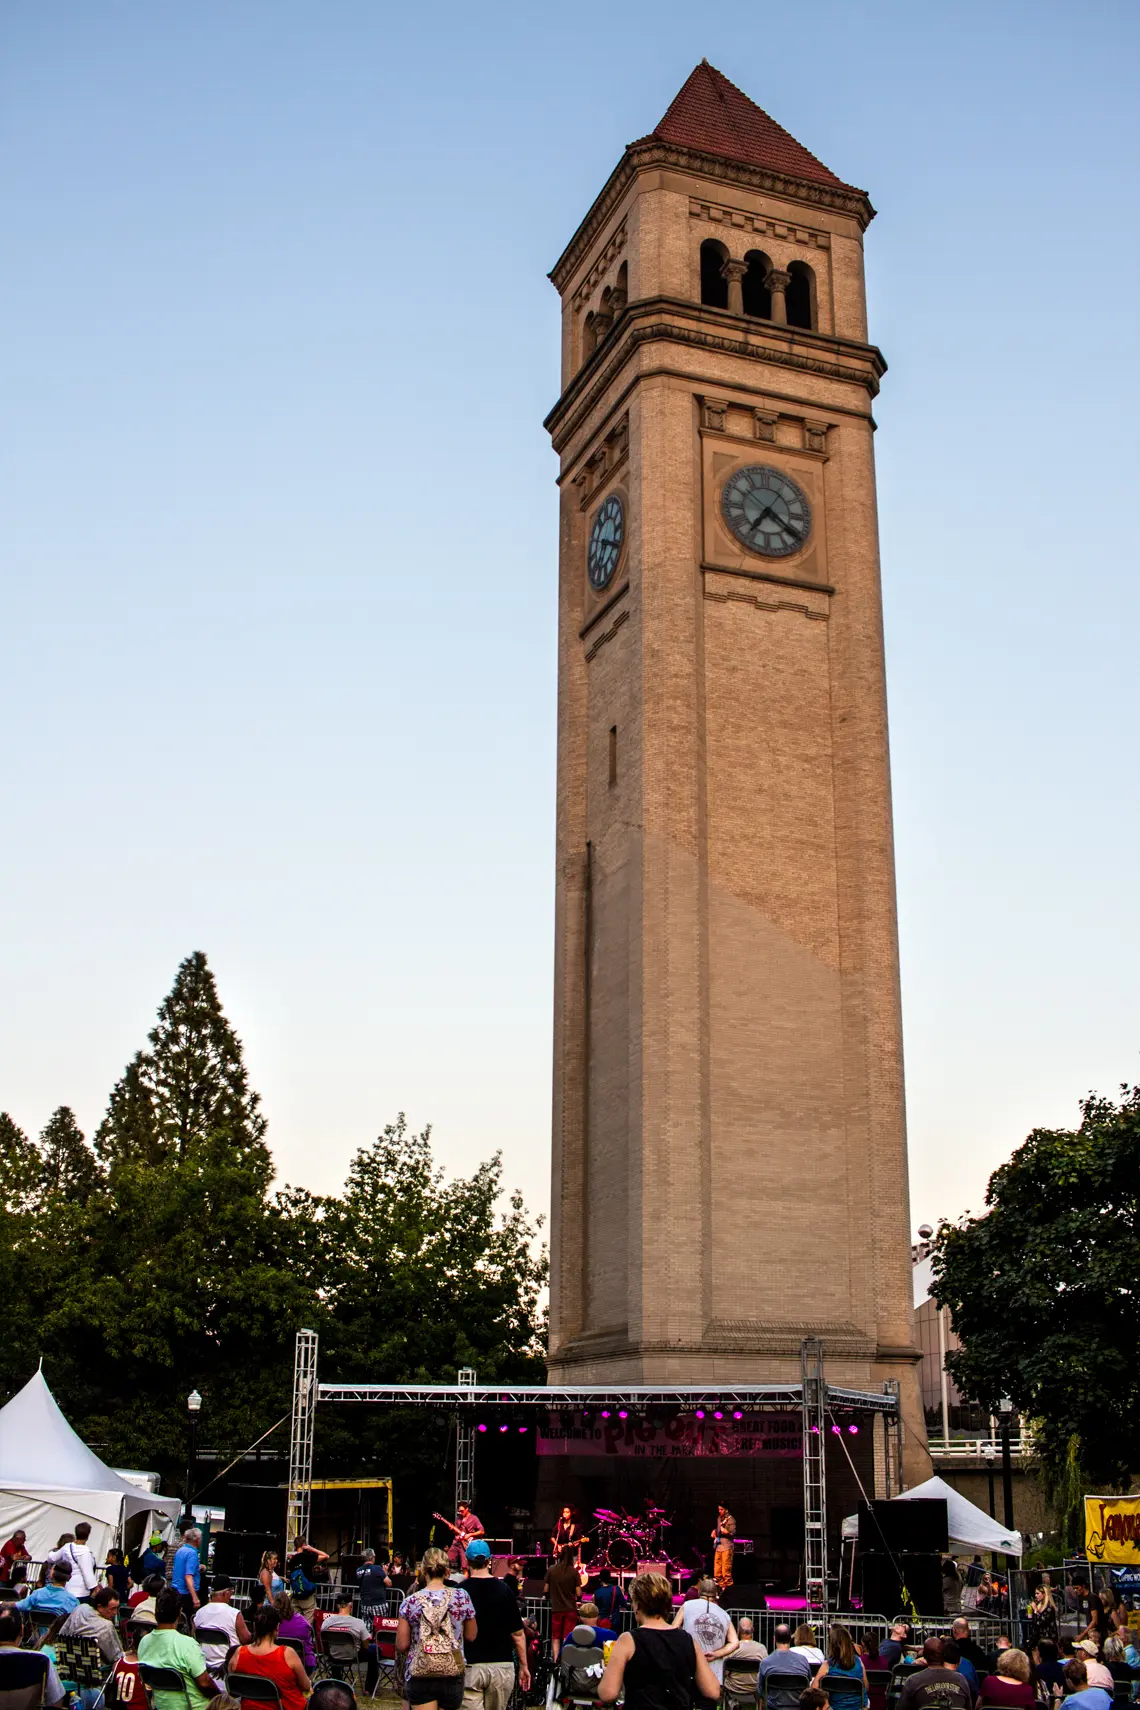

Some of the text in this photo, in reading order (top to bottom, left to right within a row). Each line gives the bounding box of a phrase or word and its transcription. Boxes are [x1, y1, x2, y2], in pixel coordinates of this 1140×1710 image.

[731, 1420, 765, 1433] GREAT
[767, 1420, 795, 1433] FOOD
[540, 1427, 586, 1439] WELCOME
[635, 1445, 696, 1456] IN THE PARK
[116, 1671, 135, 1702] 10
